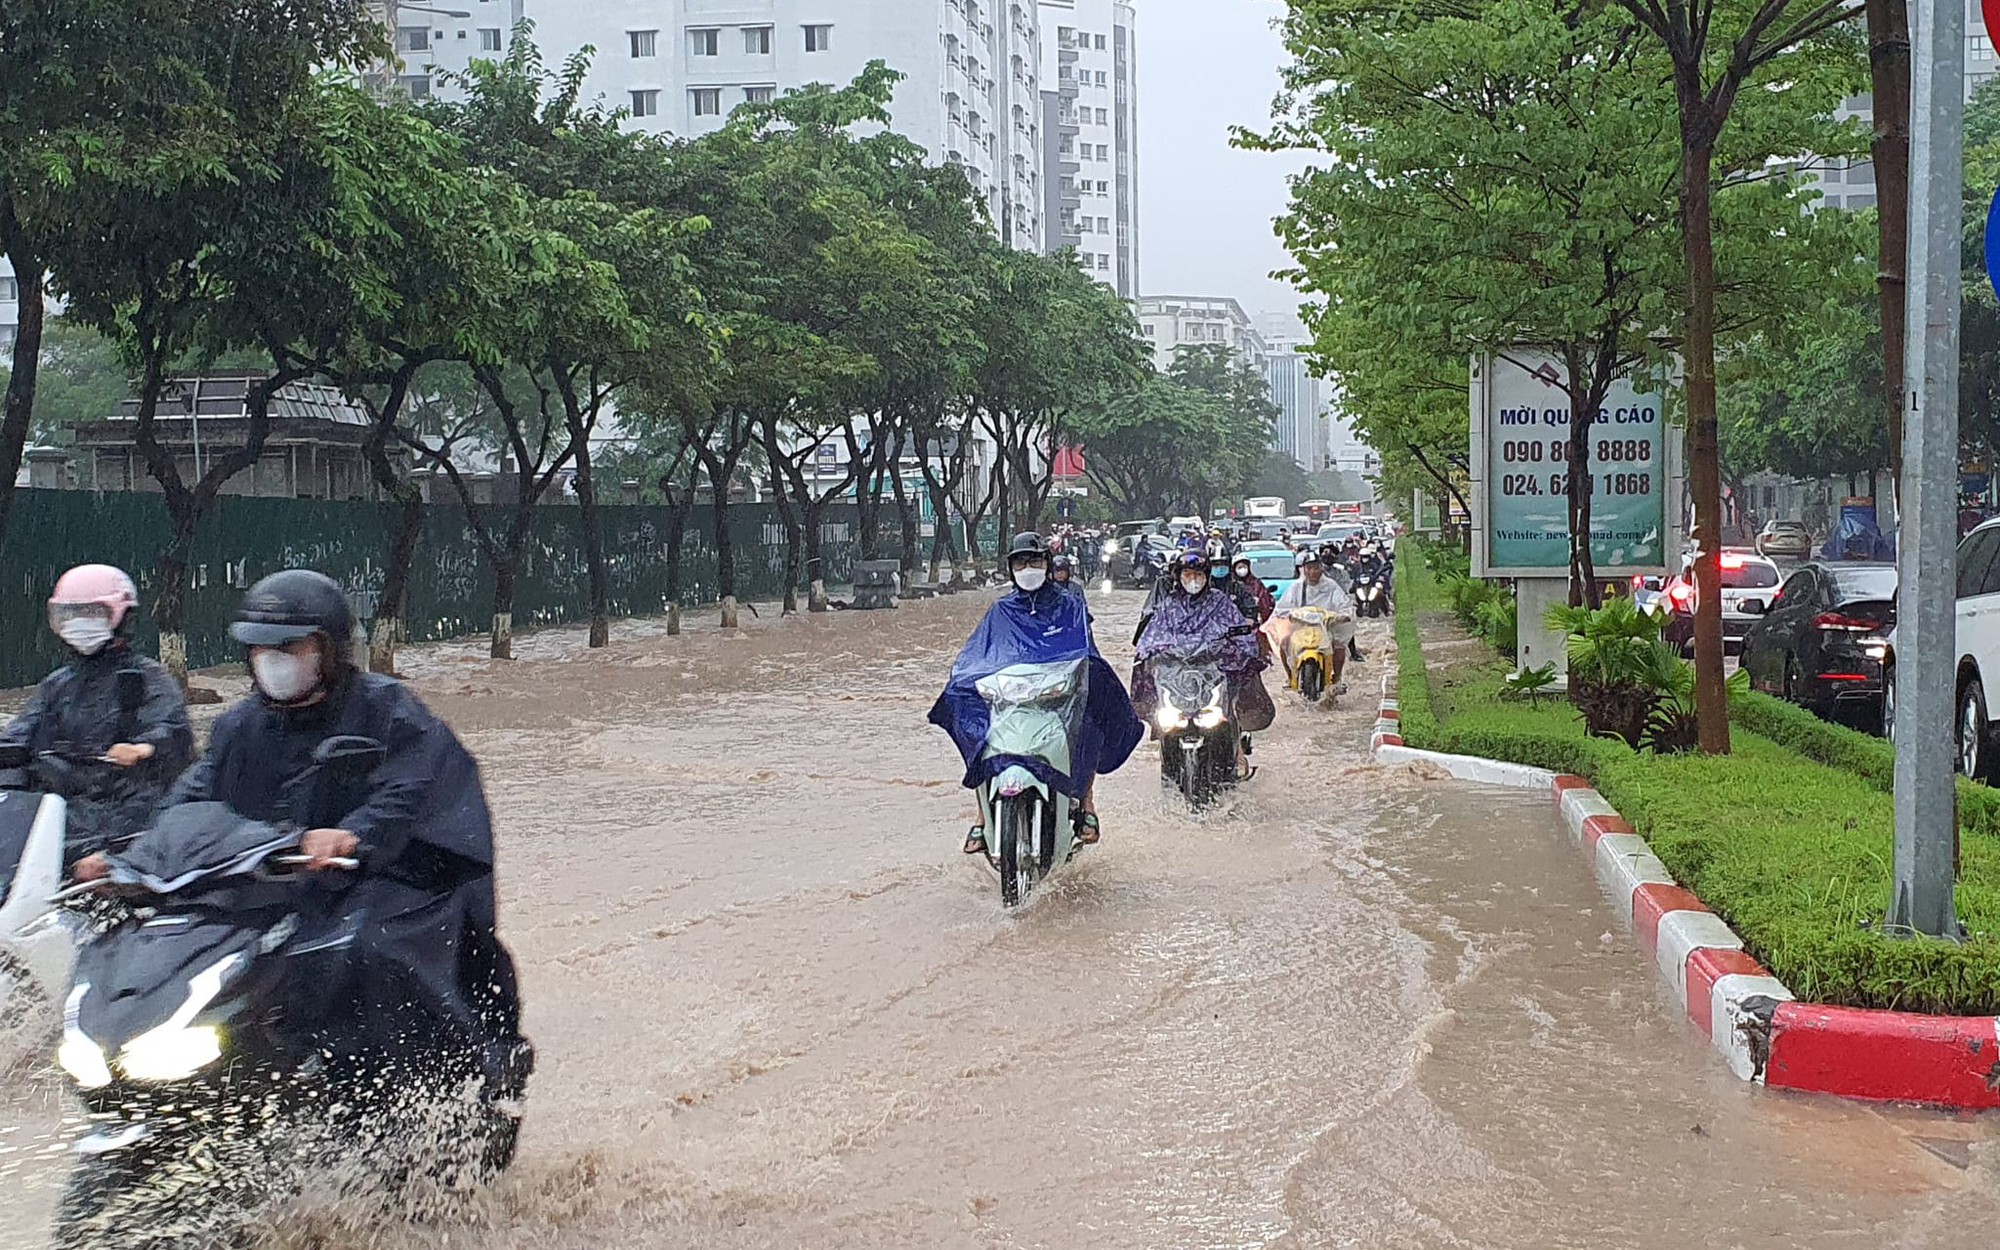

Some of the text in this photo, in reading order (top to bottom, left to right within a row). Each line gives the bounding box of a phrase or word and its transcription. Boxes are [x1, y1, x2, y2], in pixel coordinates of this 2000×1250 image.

[1501, 404, 1654, 427] MỜI QUG CÁO
[1503, 440, 1543, 462] 090
[1597, 439, 1650, 462] 8888
[1503, 473, 1543, 496] 024.
[1603, 473, 1650, 496] 1868
[1497, 529, 1543, 540] Website:
